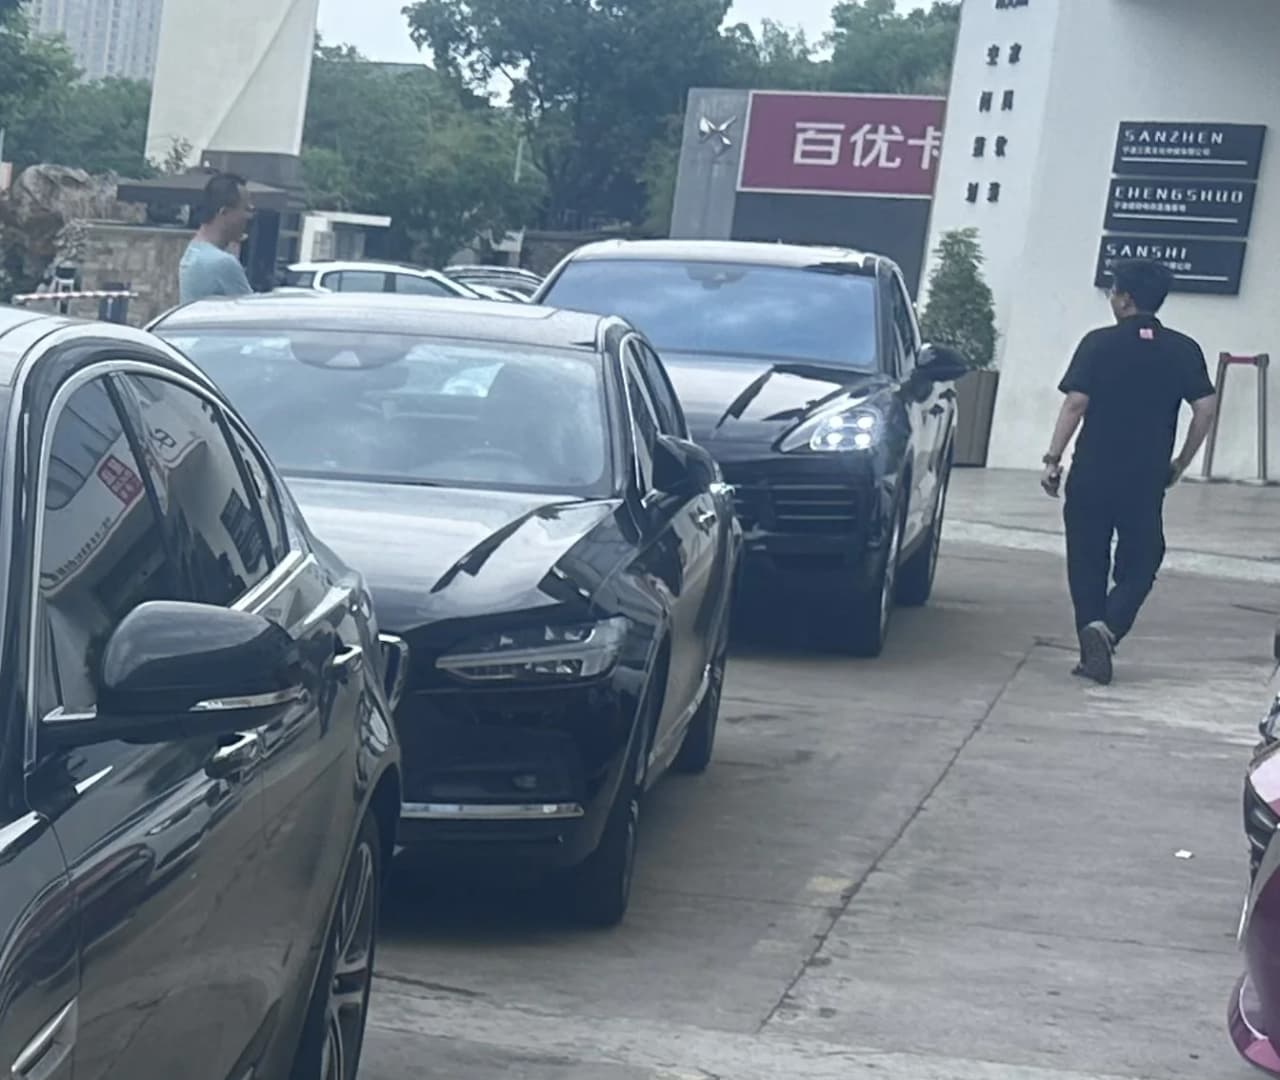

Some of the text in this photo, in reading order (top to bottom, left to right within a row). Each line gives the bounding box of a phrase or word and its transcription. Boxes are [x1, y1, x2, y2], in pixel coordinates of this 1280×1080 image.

[793, 121, 942, 171] 百优卡
[1124, 129, 1224, 145] SANZHEN
[1114, 185, 1244, 204] CHENGSHUO
[1105, 243, 1188, 260] SANSHI
